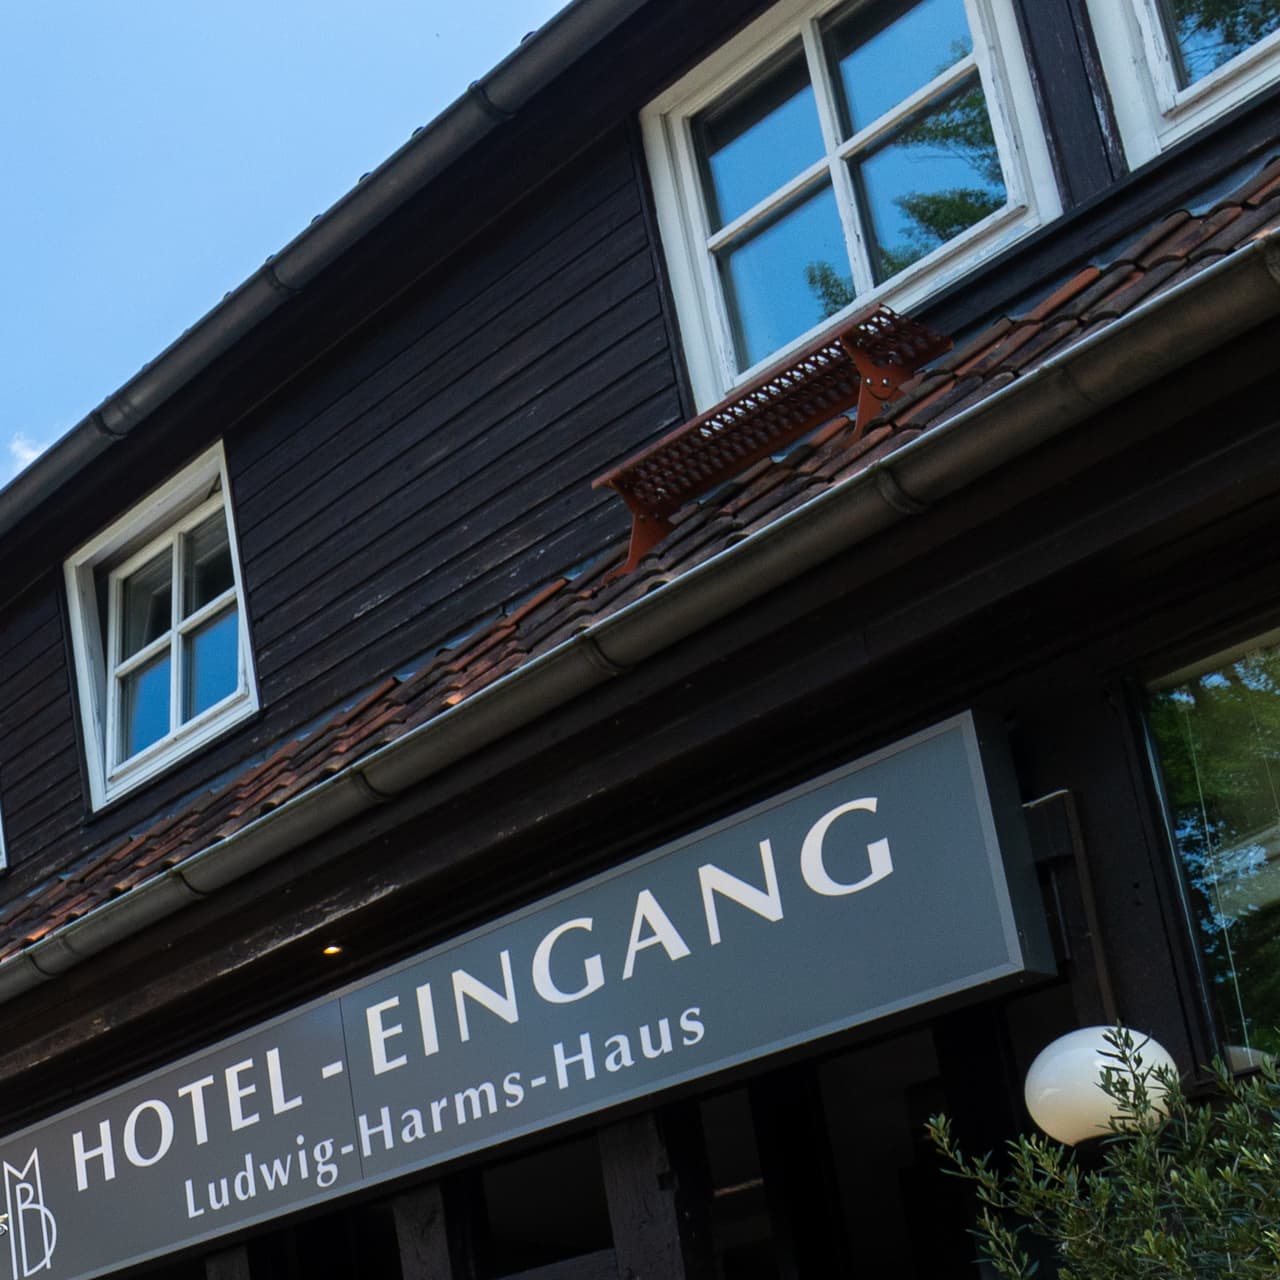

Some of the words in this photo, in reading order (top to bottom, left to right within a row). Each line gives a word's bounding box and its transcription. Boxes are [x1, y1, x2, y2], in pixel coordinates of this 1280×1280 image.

[72, 1047, 303, 1192] HOTEL
[365, 797, 894, 1076] EINGANG
[184, 1007, 705, 1219] Ludwig-Harms-Haus
